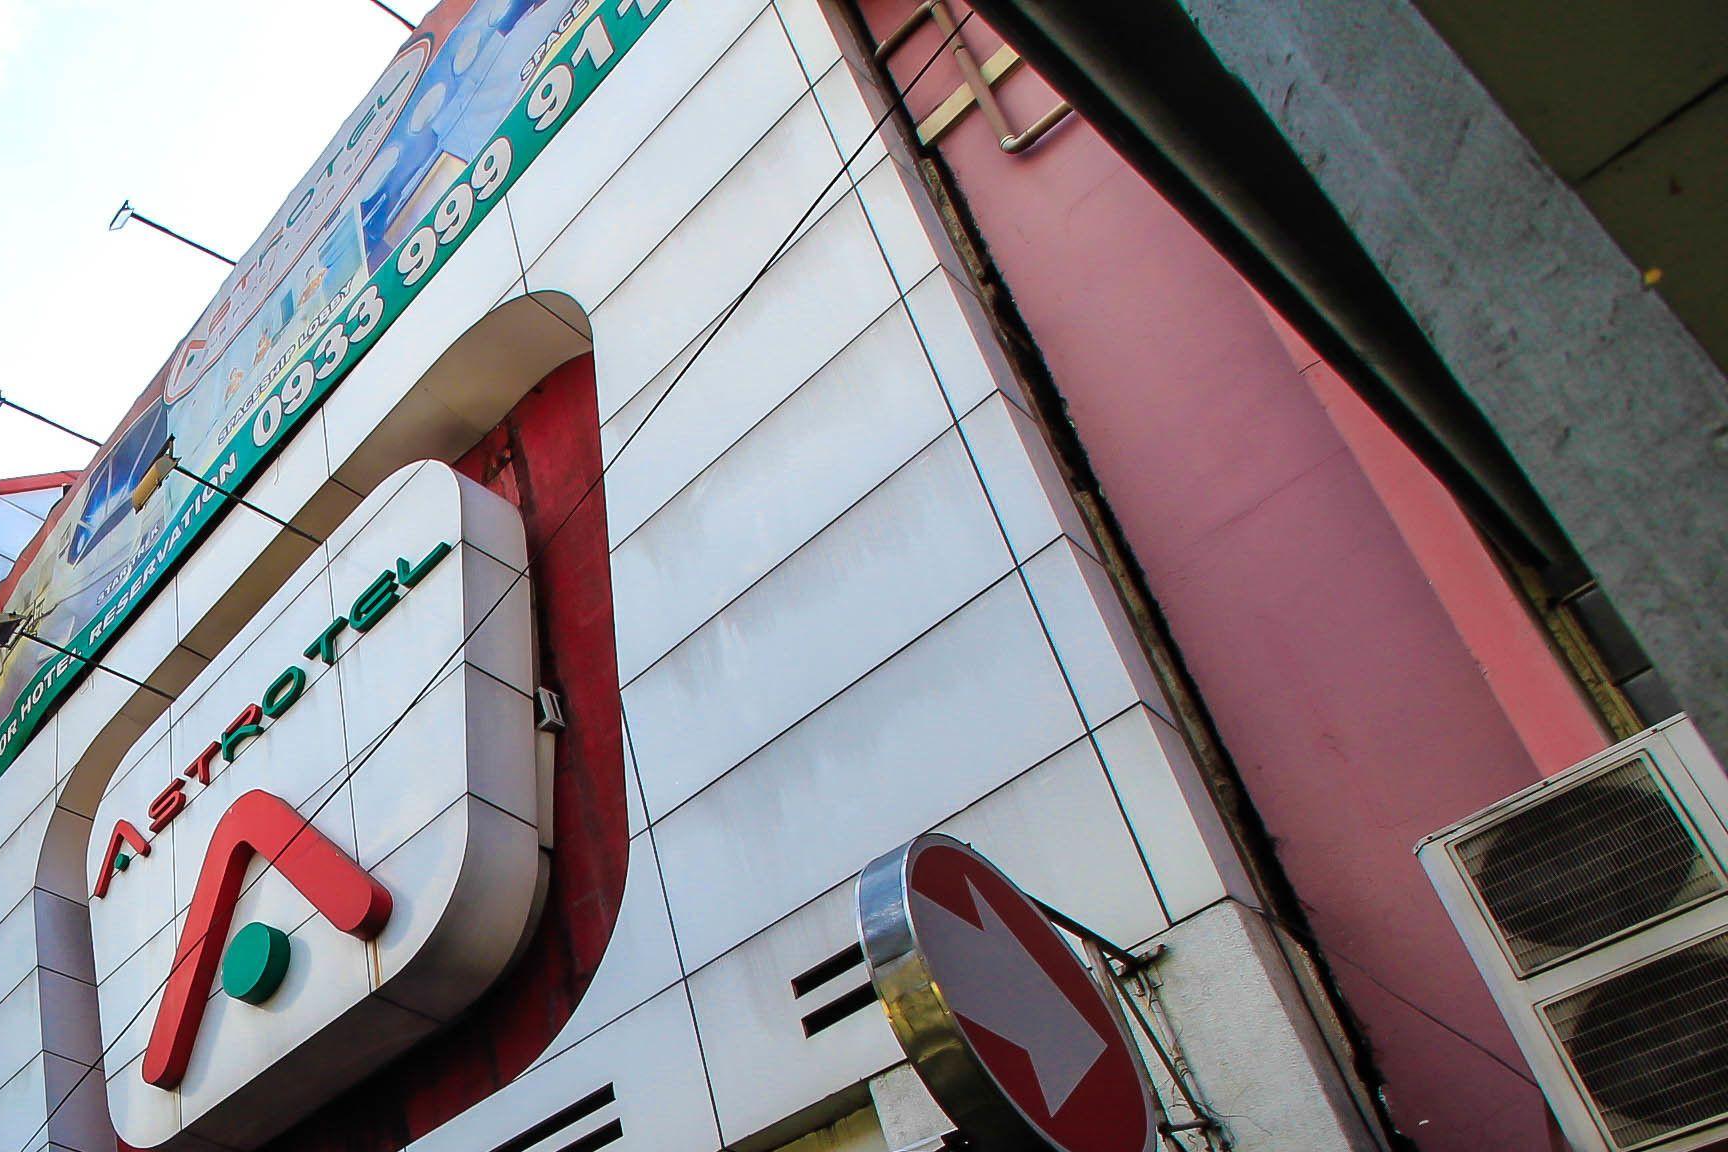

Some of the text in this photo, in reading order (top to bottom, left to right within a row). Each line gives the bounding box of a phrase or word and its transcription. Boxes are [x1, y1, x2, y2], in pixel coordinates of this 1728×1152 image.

[21, 648, 82, 721] HOTEL
[88, 452, 237, 646] RESERVATION
[252, 284, 385, 447] 0933
[397, 136, 512, 287] 999
[217, 278, 353, 446] SPACESHIP LOBBY
[94, 541, 452, 899] ASTROTEL
